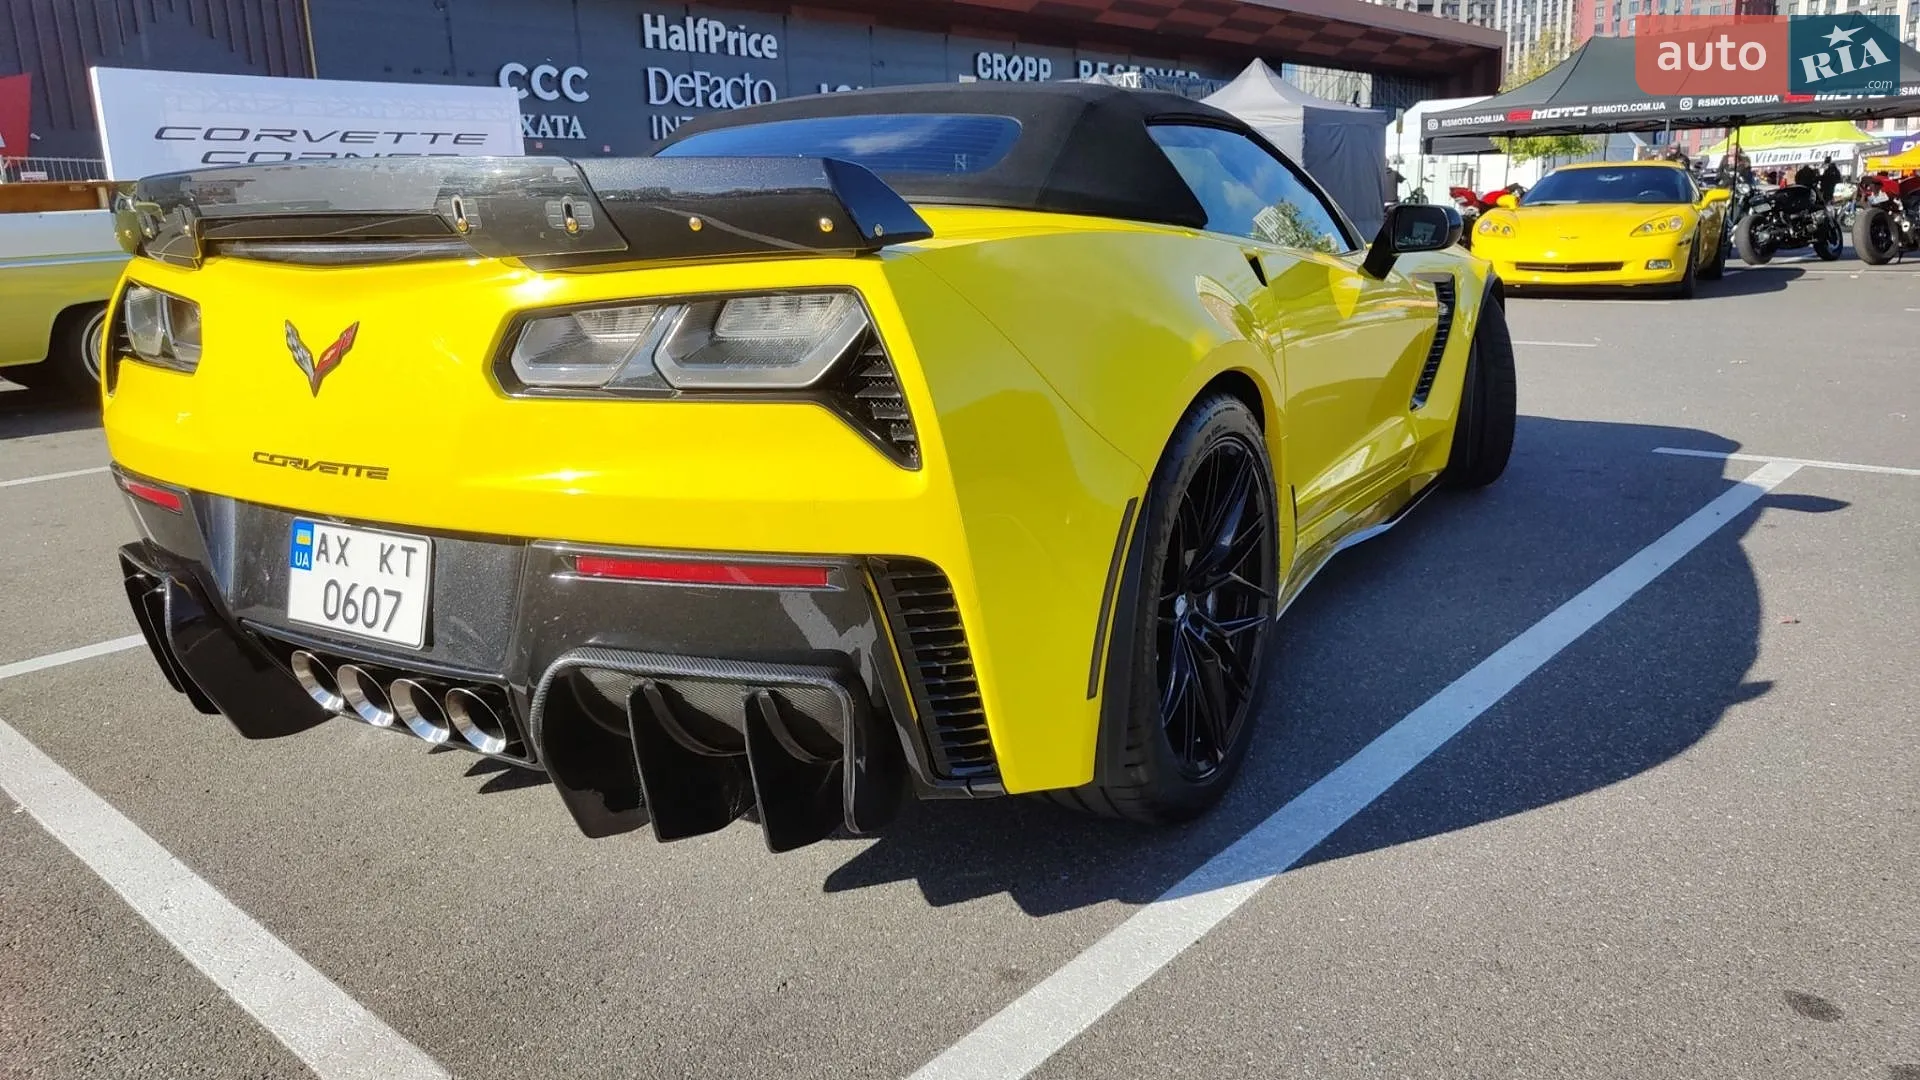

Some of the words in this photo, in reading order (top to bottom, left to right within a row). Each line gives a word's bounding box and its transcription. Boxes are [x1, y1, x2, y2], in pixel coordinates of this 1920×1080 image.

[642, 13, 777, 59] HalfPrice
[977, 52, 1052, 82] CROPP
[499, 62, 590, 103] CCC
[647, 66, 777, 110] DeFacto
[1592, 102, 1666, 115] RSMOTO.COM.UA
[1698, 94, 1780, 108] RSMOTO.COM.UA
[154, 126, 489, 146] CORVETTE
[1755, 151, 1802, 164] Vitamin
[253, 451, 389, 480] CORVETTE
[295, 551, 310, 568] UA
[316, 532, 350, 567] AX
[379, 542, 417, 578] KT
[323, 578, 403, 633] 0607
